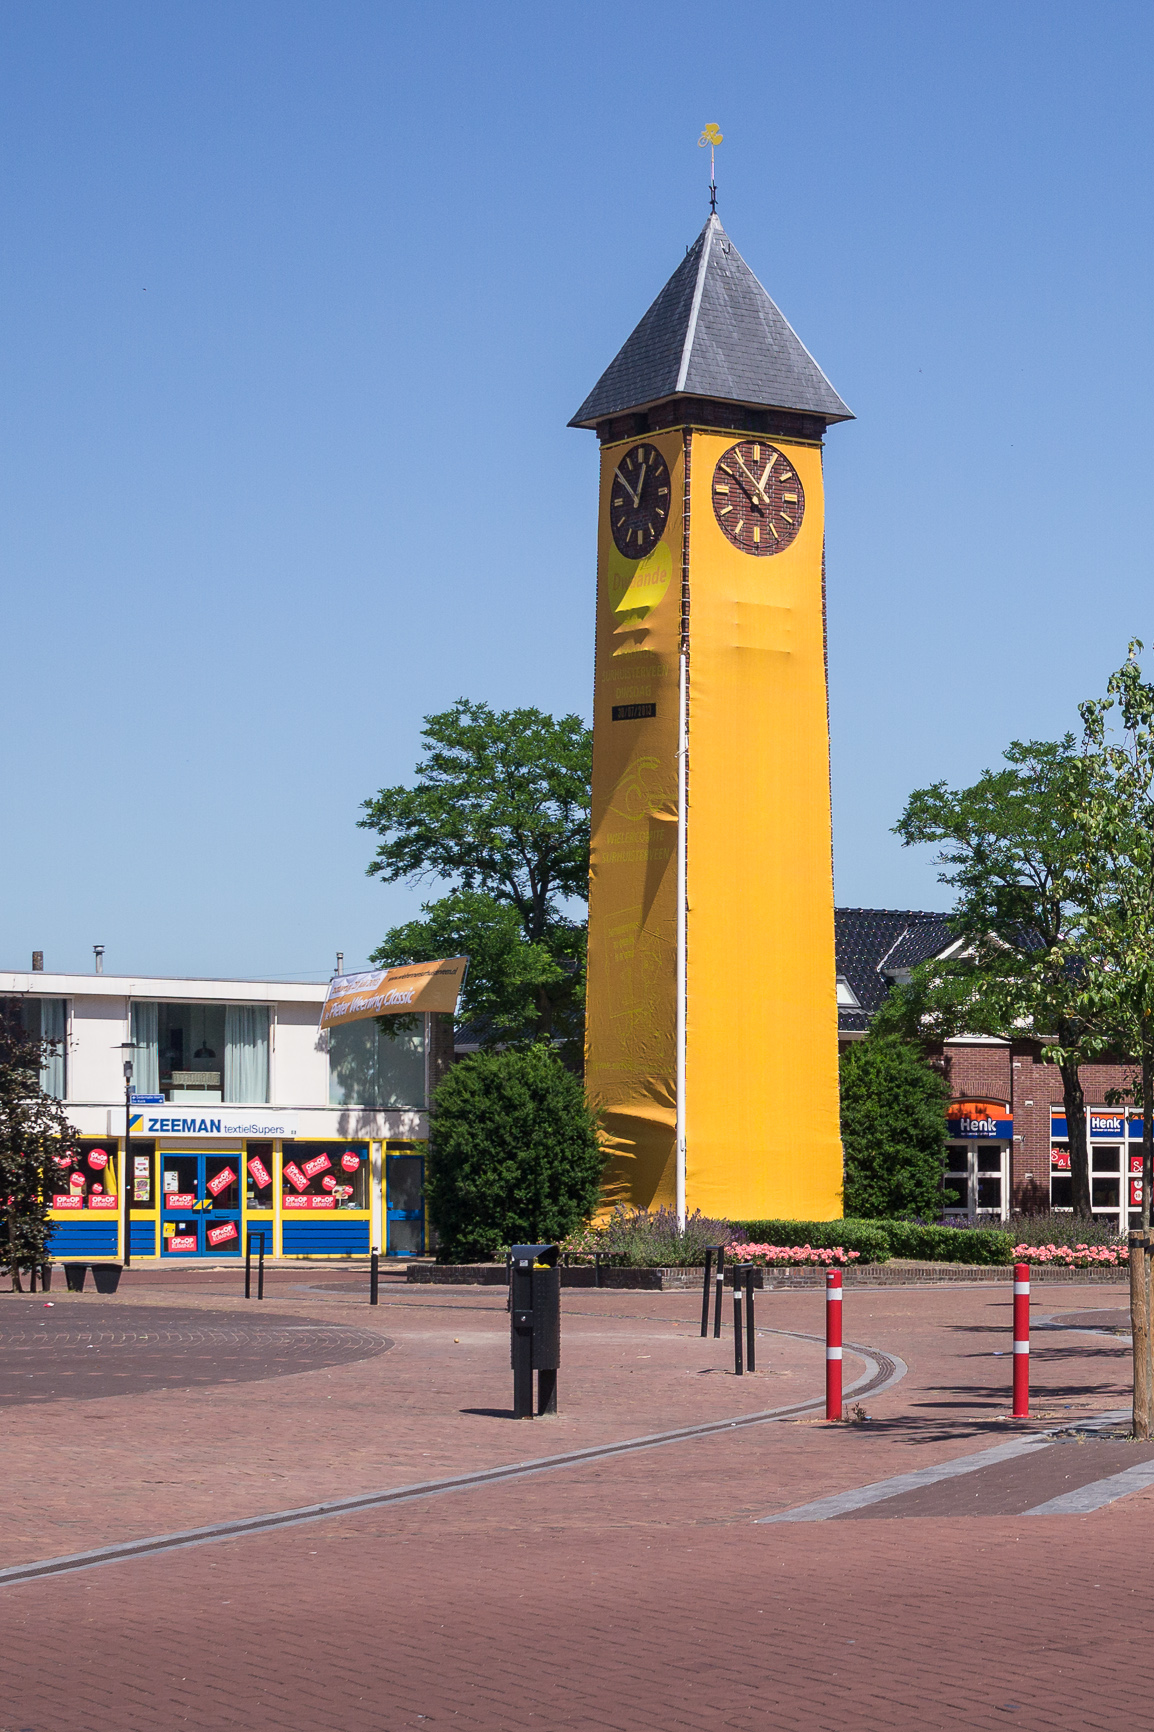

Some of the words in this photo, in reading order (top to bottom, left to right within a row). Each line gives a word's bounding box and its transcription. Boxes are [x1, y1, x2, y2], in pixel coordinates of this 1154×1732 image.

[613, 566, 667, 591] Dwaande
[616, 685, 651, 699] DINSDAG
[330, 1001, 351, 1017] Pieter
[350, 992, 385, 1013] Weening
[384, 987, 415, 1006] Classic
[148, 1118, 221, 1133] ZEEMAN
[224, 1124, 285, 1135] textielSupers
[960, 1117, 997, 1131] Henk
[1092, 1117, 1120, 1128] Henk
